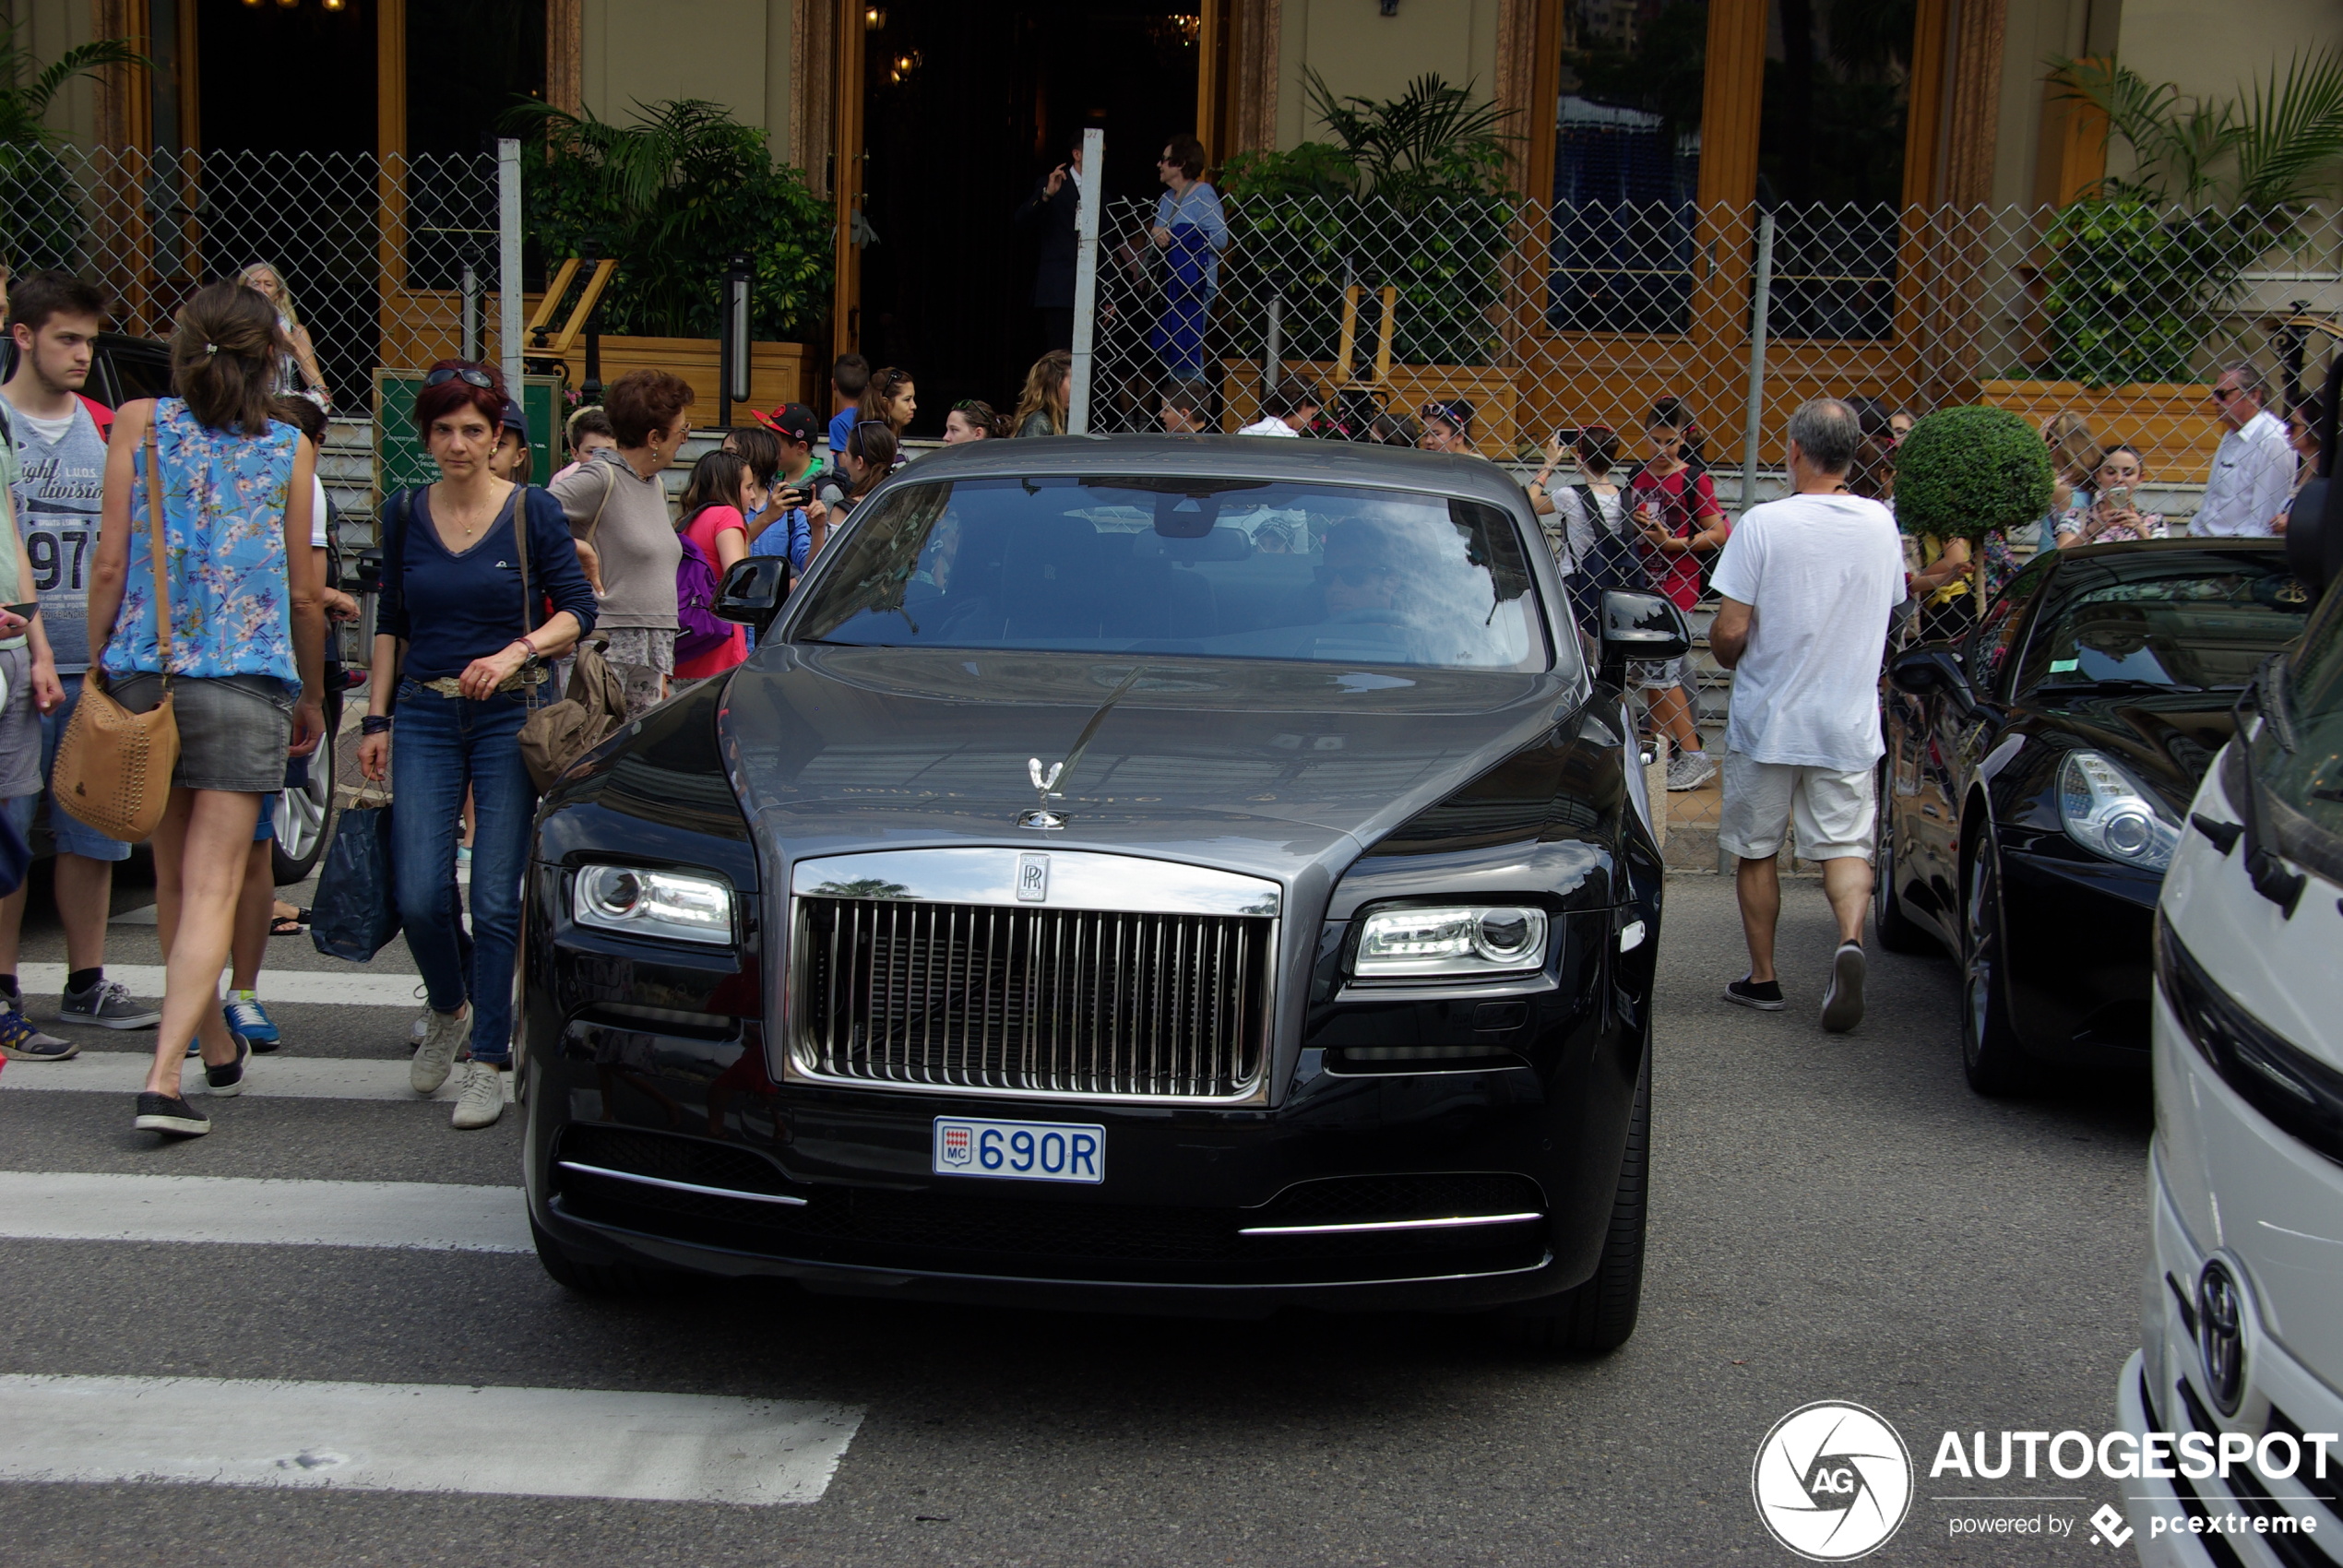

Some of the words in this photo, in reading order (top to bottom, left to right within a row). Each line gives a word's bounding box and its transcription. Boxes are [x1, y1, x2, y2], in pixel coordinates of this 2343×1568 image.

[1023, 856, 1046, 864] ROLLS
[1020, 890, 1041, 898] ROYCE
[947, 1147, 967, 1159] MC
[980, 1128, 1097, 1175] 690R
